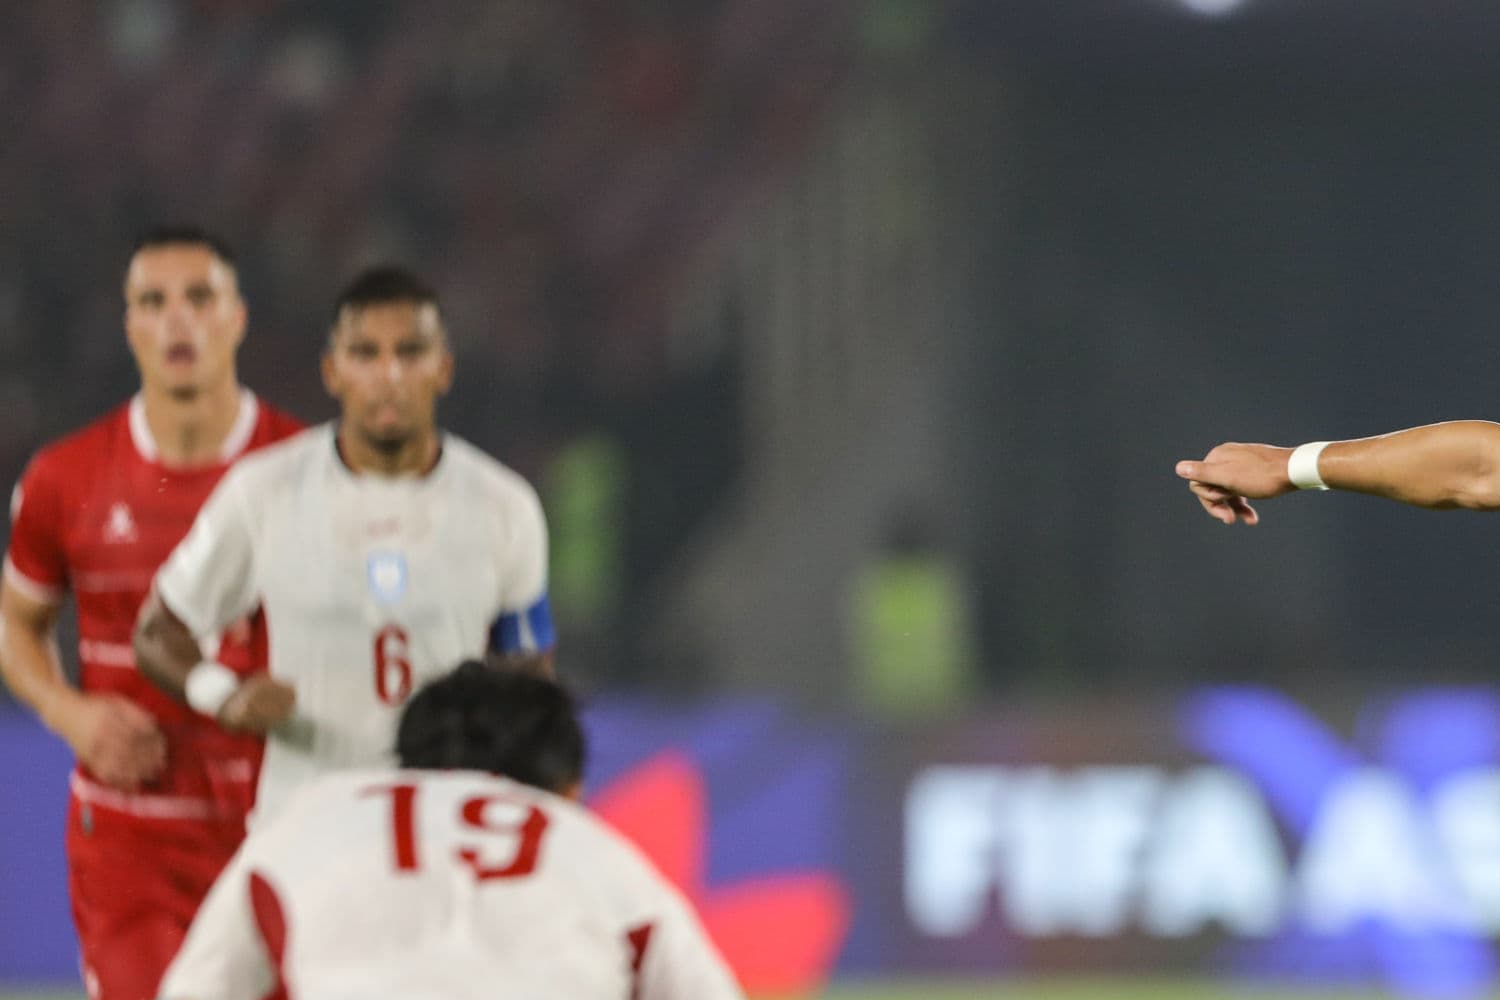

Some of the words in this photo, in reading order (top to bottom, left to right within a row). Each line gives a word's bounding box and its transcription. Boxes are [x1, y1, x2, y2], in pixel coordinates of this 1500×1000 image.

[373, 622, 412, 706] 6
[358, 782, 551, 880] 19
[903, 764, 1286, 938] FIFA
